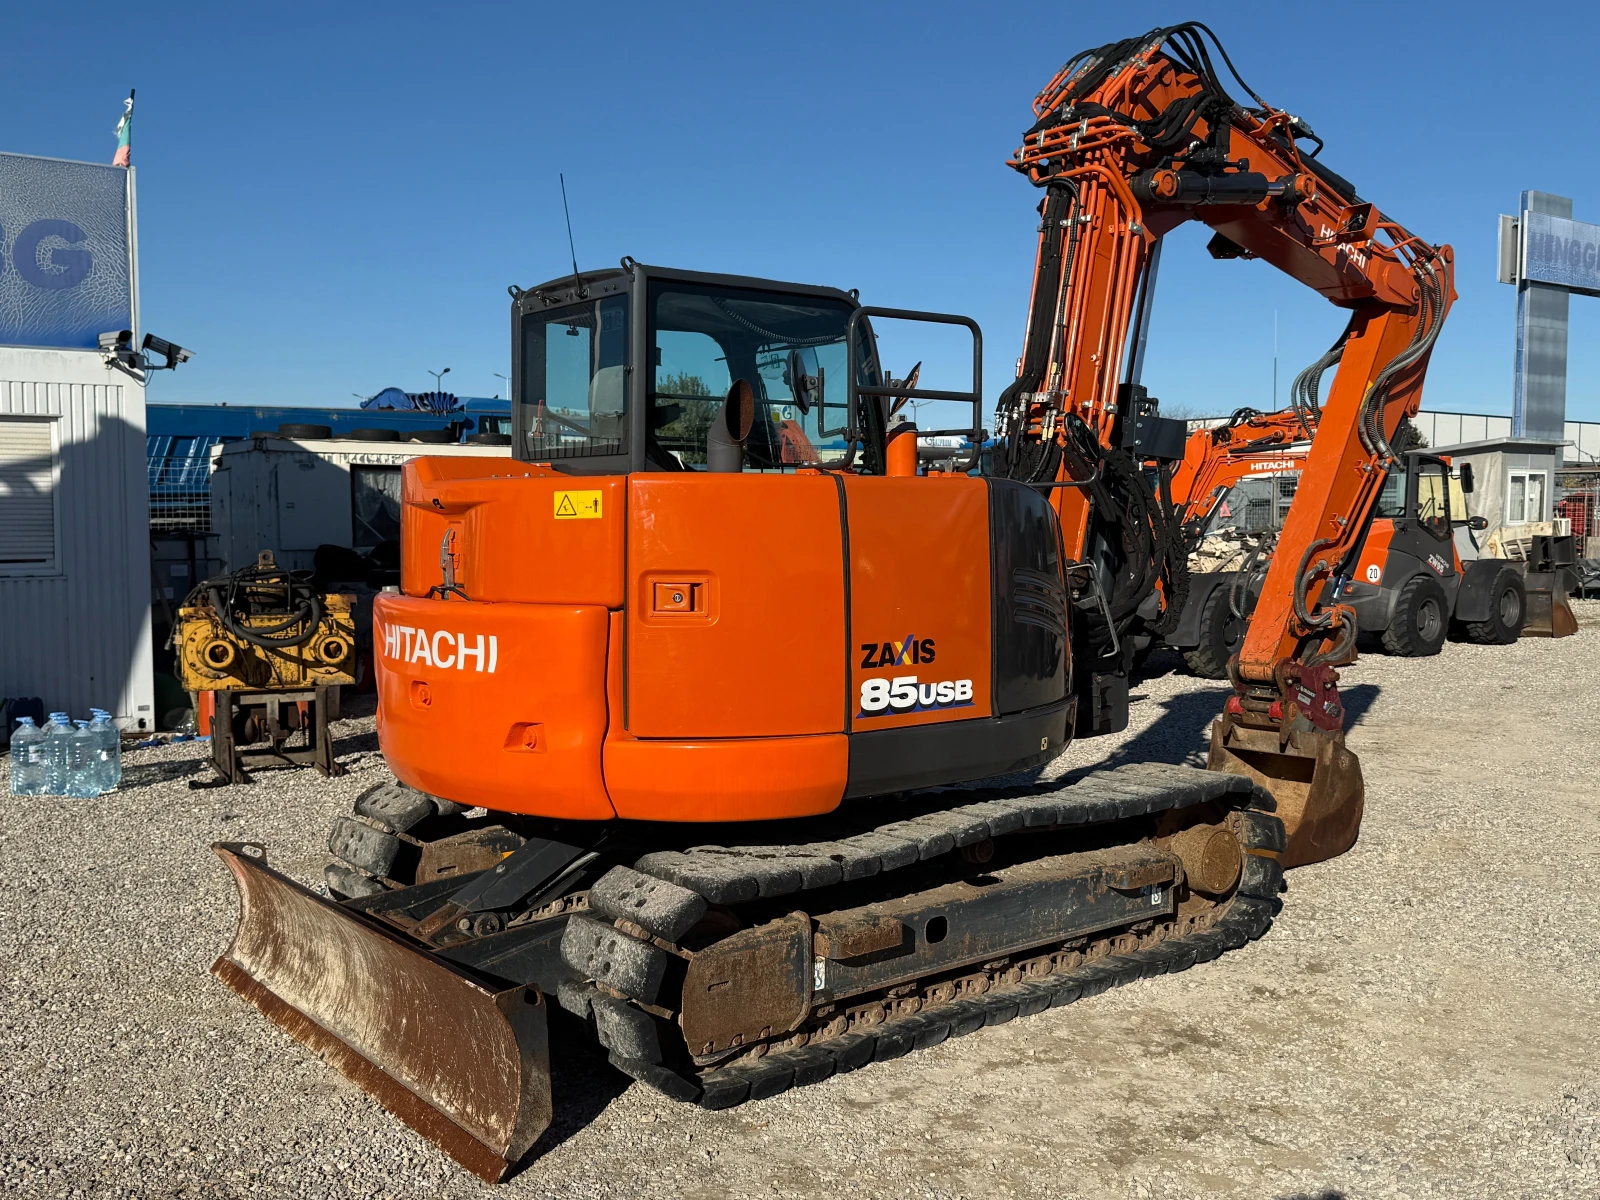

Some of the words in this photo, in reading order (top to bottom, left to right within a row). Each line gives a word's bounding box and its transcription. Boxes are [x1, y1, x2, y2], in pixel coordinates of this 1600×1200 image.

[0, 218, 93, 290] G
[1320, 224, 1367, 269] HIACHI
[1250, 460, 1295, 470] HITACHI
[1369, 568, 1378, 579] 20
[384, 622, 498, 673] HITACHI
[861, 634, 936, 669] ZAXIS
